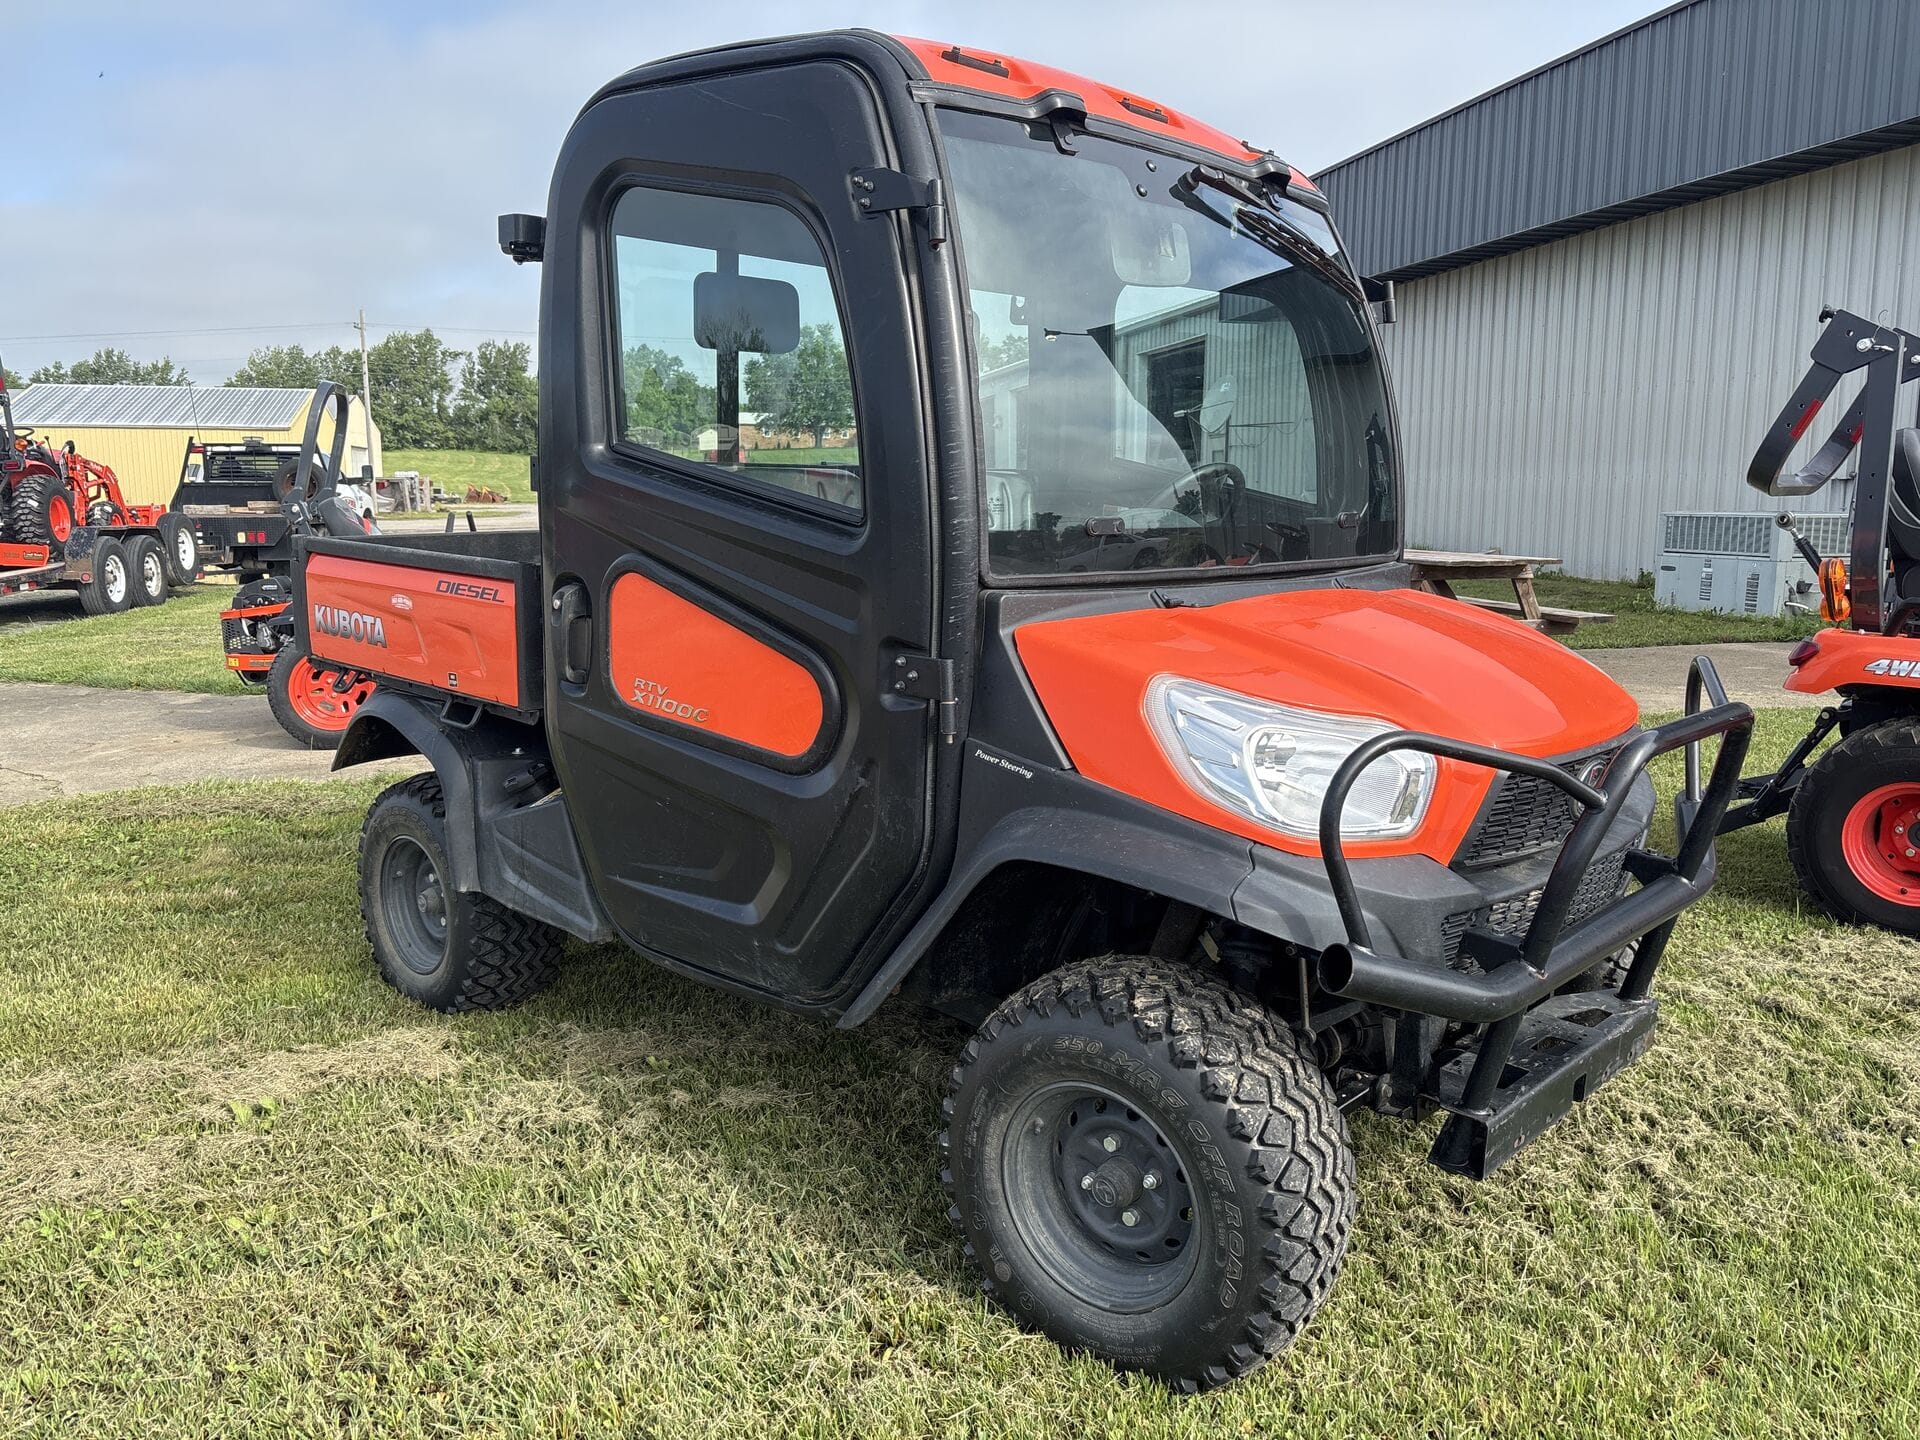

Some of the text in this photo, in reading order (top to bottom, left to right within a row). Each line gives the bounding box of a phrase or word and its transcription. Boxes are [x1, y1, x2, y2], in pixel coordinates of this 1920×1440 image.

[435, 579, 505, 603] DIESEL
[314, 603, 388, 649] KUBOTA
[634, 677, 669, 696] RTV
[631, 688, 710, 722] X1100C
[974, 749, 1033, 779] Power Steering
[1054, 1036, 1103, 1055] 350
[1110, 1049, 1189, 1110] MAG
[1187, 1119, 1237, 1194] OFF
[1219, 1200, 1245, 1309] ROAD
